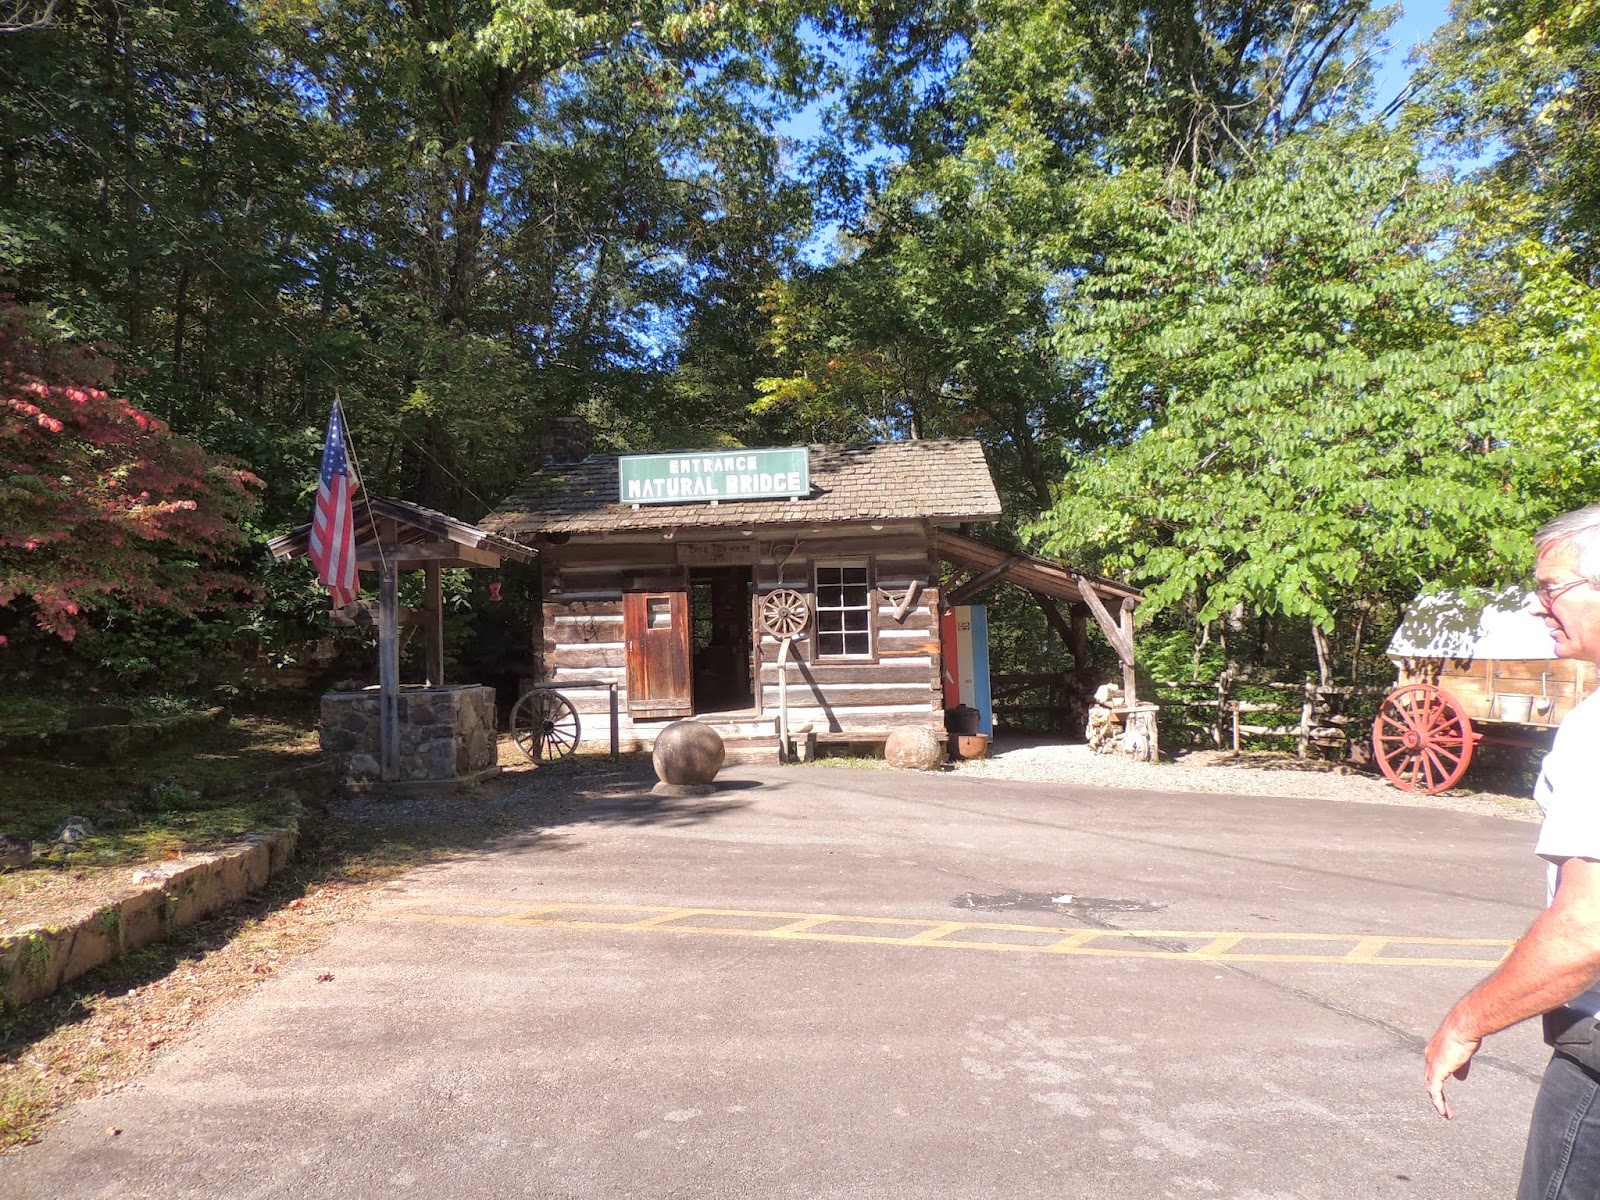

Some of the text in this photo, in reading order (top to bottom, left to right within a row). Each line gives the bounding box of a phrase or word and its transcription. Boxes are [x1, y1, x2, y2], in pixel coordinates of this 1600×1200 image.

[669, 456, 757, 474] ENTRANCE
[628, 472, 801, 498] NATURAL BRIDGE
